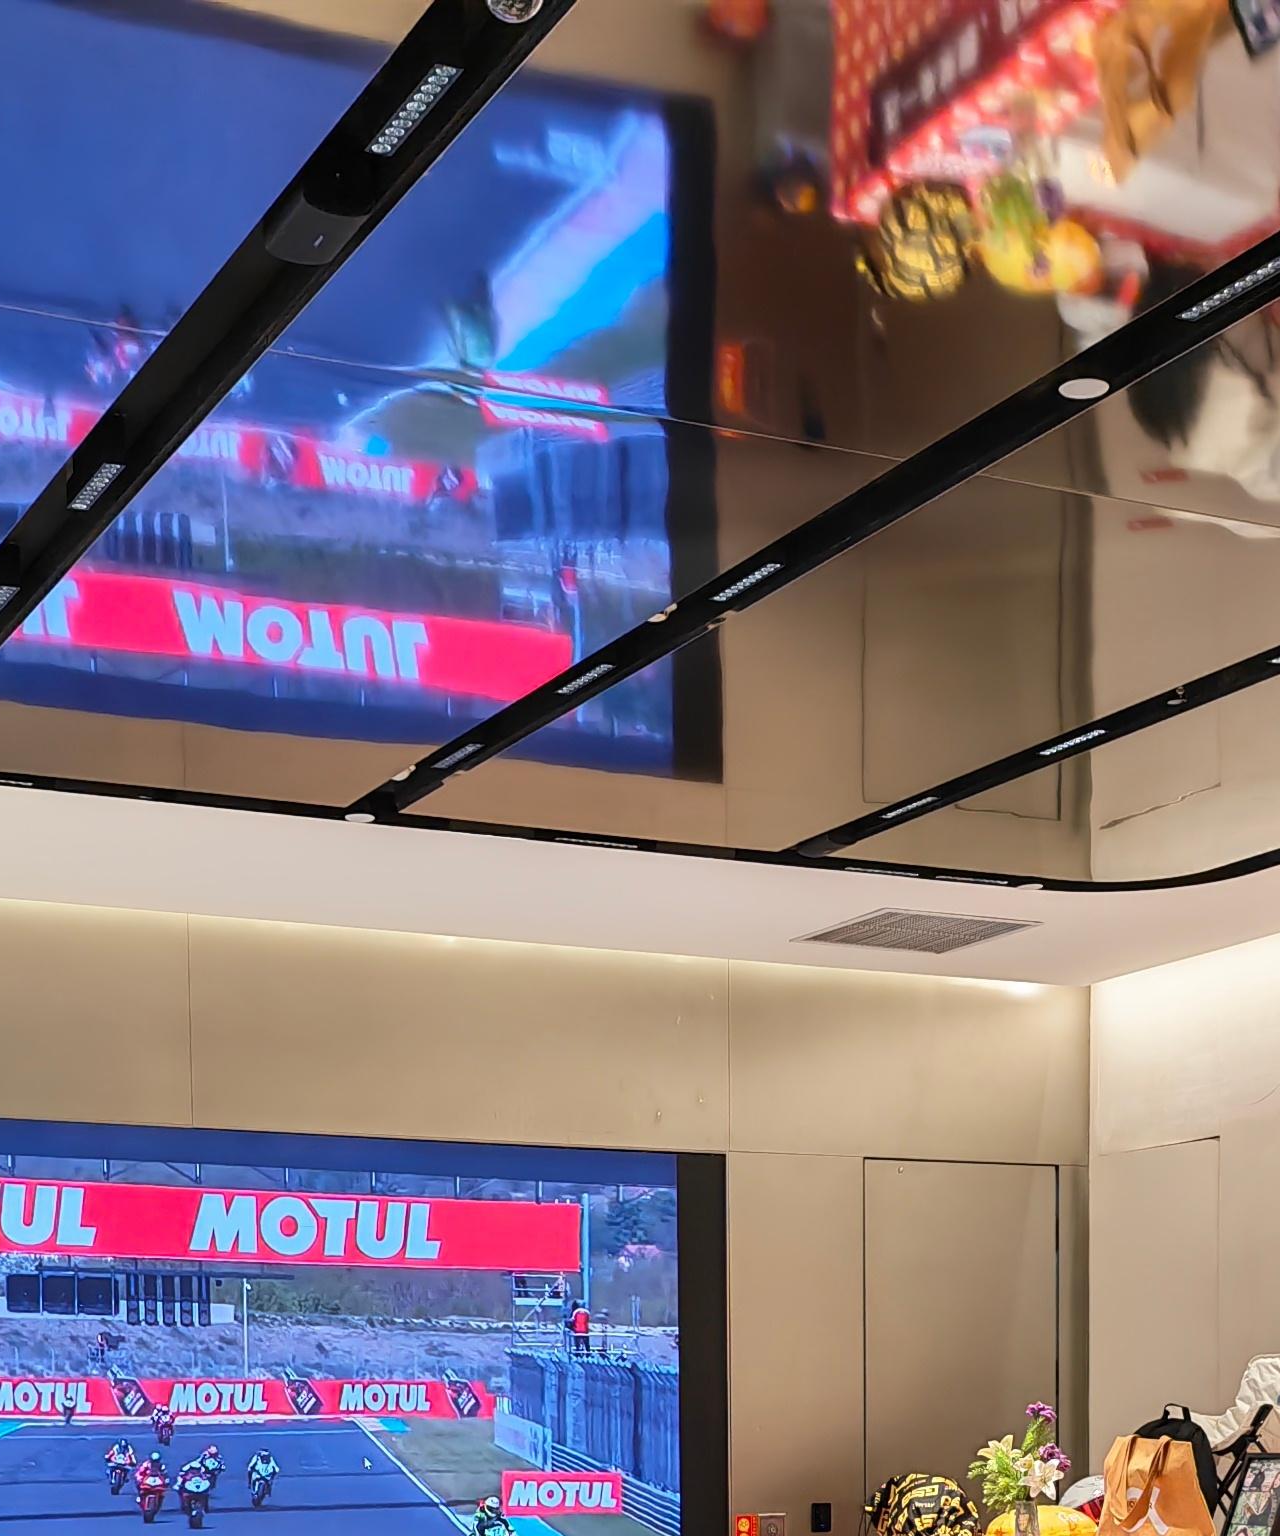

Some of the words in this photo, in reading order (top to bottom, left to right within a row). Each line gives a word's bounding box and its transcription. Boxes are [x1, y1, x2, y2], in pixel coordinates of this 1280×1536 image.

[191, 1195, 441, 1260] MOTUL
[169, 1382, 268, 1413] MOTUL
[340, 1383, 431, 1412] MOTUL
[508, 1481, 617, 1508] MOTUL
